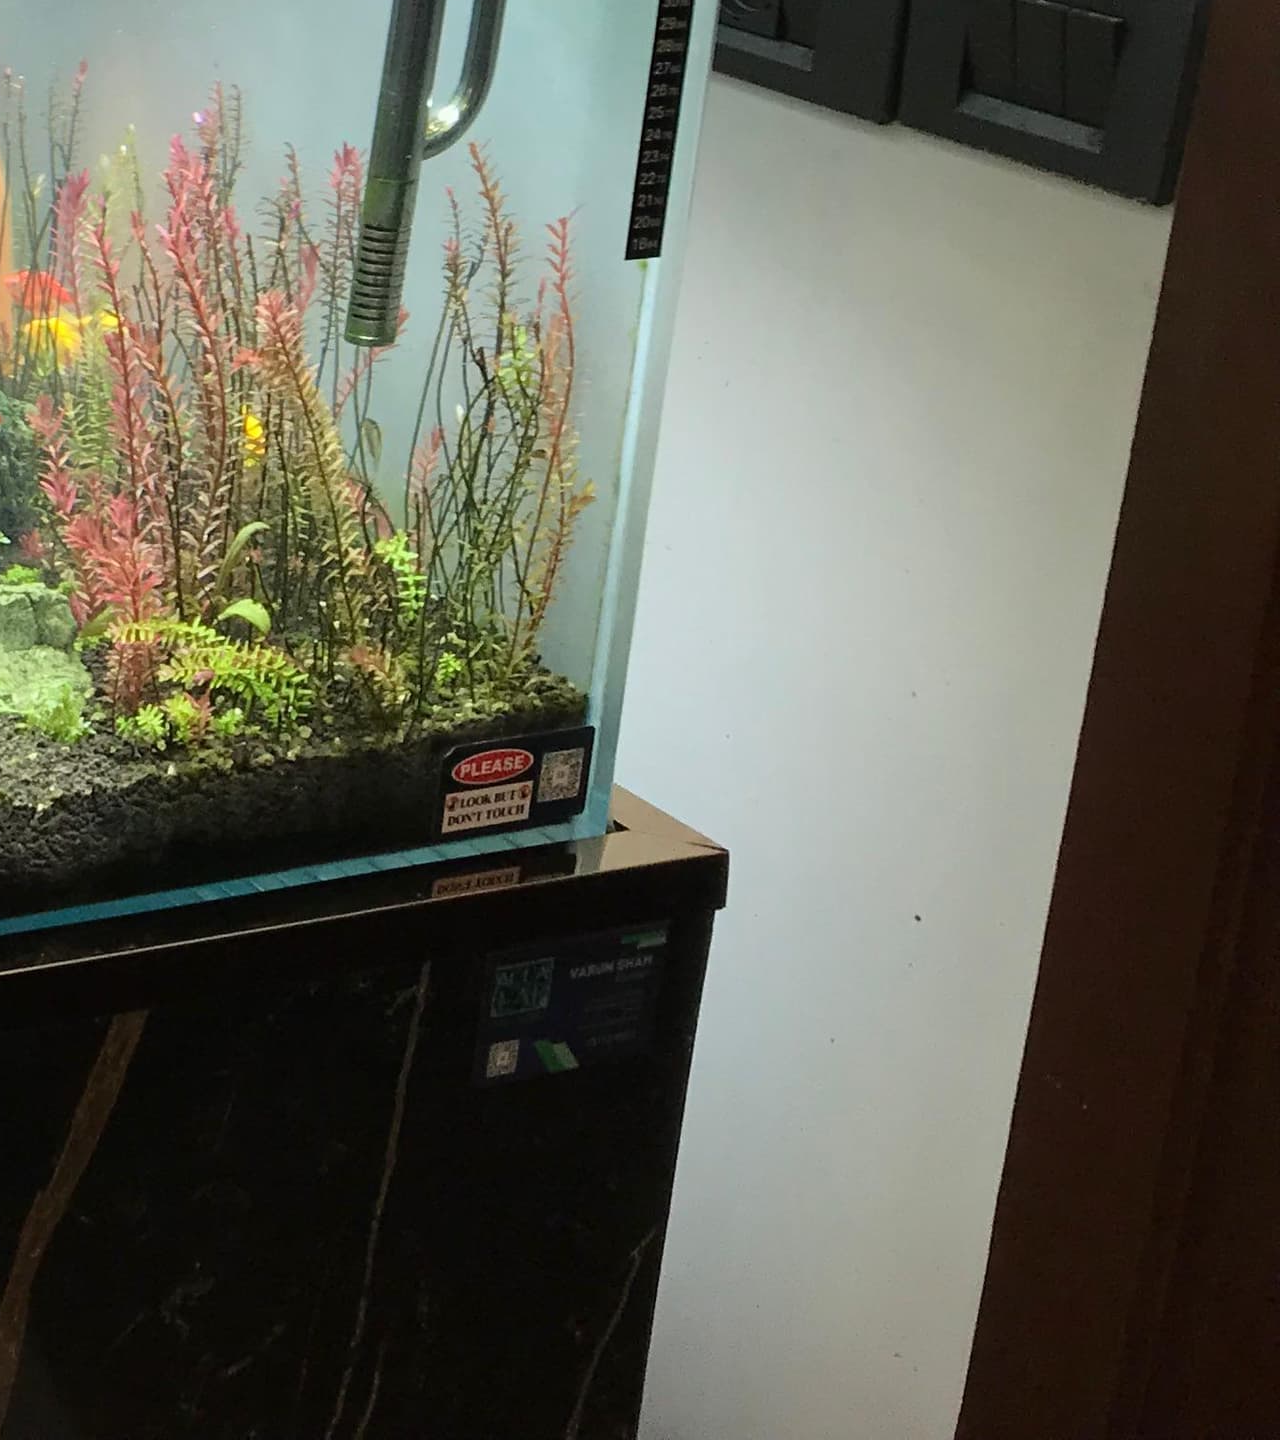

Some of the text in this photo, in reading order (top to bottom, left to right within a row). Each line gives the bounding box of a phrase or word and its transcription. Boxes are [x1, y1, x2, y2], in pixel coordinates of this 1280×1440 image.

[653, 61, 672, 76] 27
[647, 105, 665, 120] 25
[644, 127, 662, 142] 24
[641, 149, 659, 164] 23
[639, 171, 657, 185] 22
[637, 194, 653, 208] 21
[633, 215, 650, 229] 20
[459, 754, 525, 778] PLEASE
[460, 790, 516, 809] LOOK BUT
[447, 804, 525, 826] DON'T TOUCH
